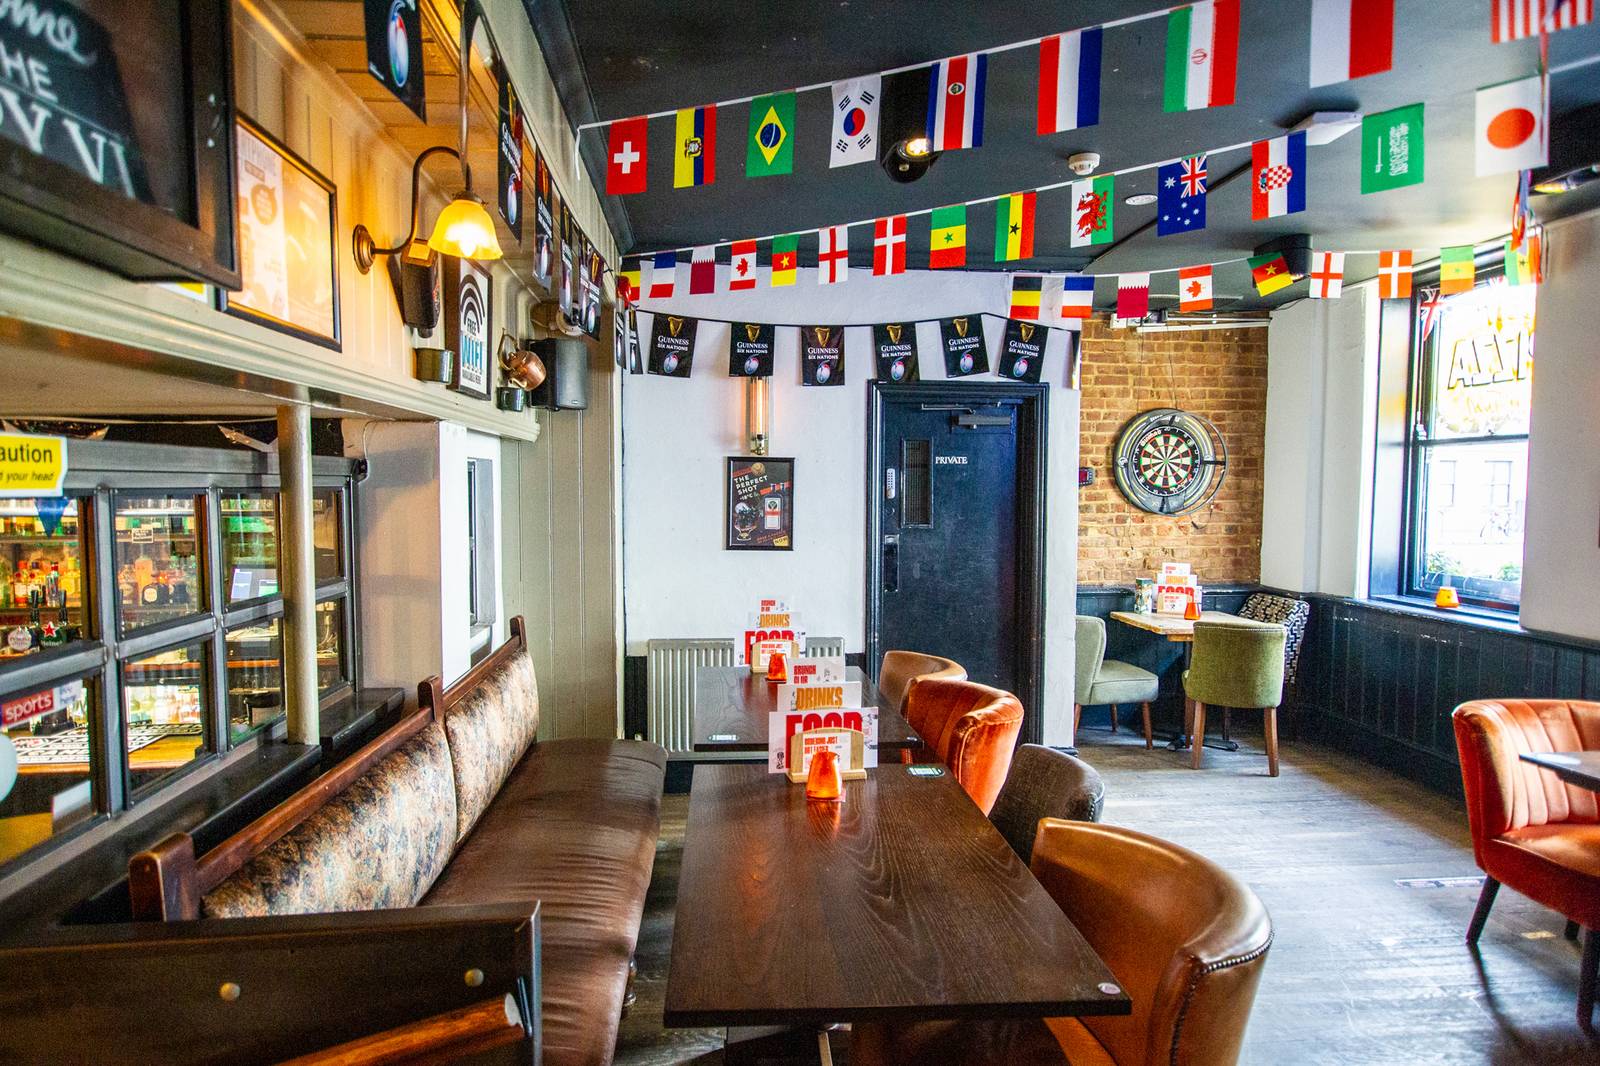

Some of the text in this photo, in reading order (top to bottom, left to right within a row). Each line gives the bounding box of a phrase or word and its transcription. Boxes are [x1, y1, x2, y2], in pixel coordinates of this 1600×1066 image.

[0, 41, 58, 103] HE
[467, 317, 476, 336] FREE
[658, 335, 690, 346] GUINNESS
[948, 336, 979, 346] GUINNESS
[1009, 340, 1040, 351] GUINNESS
[666, 344, 688, 352] NATIONS
[881, 344, 911, 352] GUINNESS
[958, 343, 979, 351] NATIONS
[1016, 349, 1038, 357] NATIONS
[0, 443, 53, 463] aution
[935, 456, 968, 464] PRIVATE
[7, 472, 28, 484] your
[32, 471, 55, 481] head
[734, 475, 750, 484] THE
[736, 475, 768, 490] PERFECT
[738, 485, 758, 496] SHOT
[760, 614, 790, 628] DRINKS
[796, 687, 843, 710] DRINKS
[6, 695, 52, 722] sports
